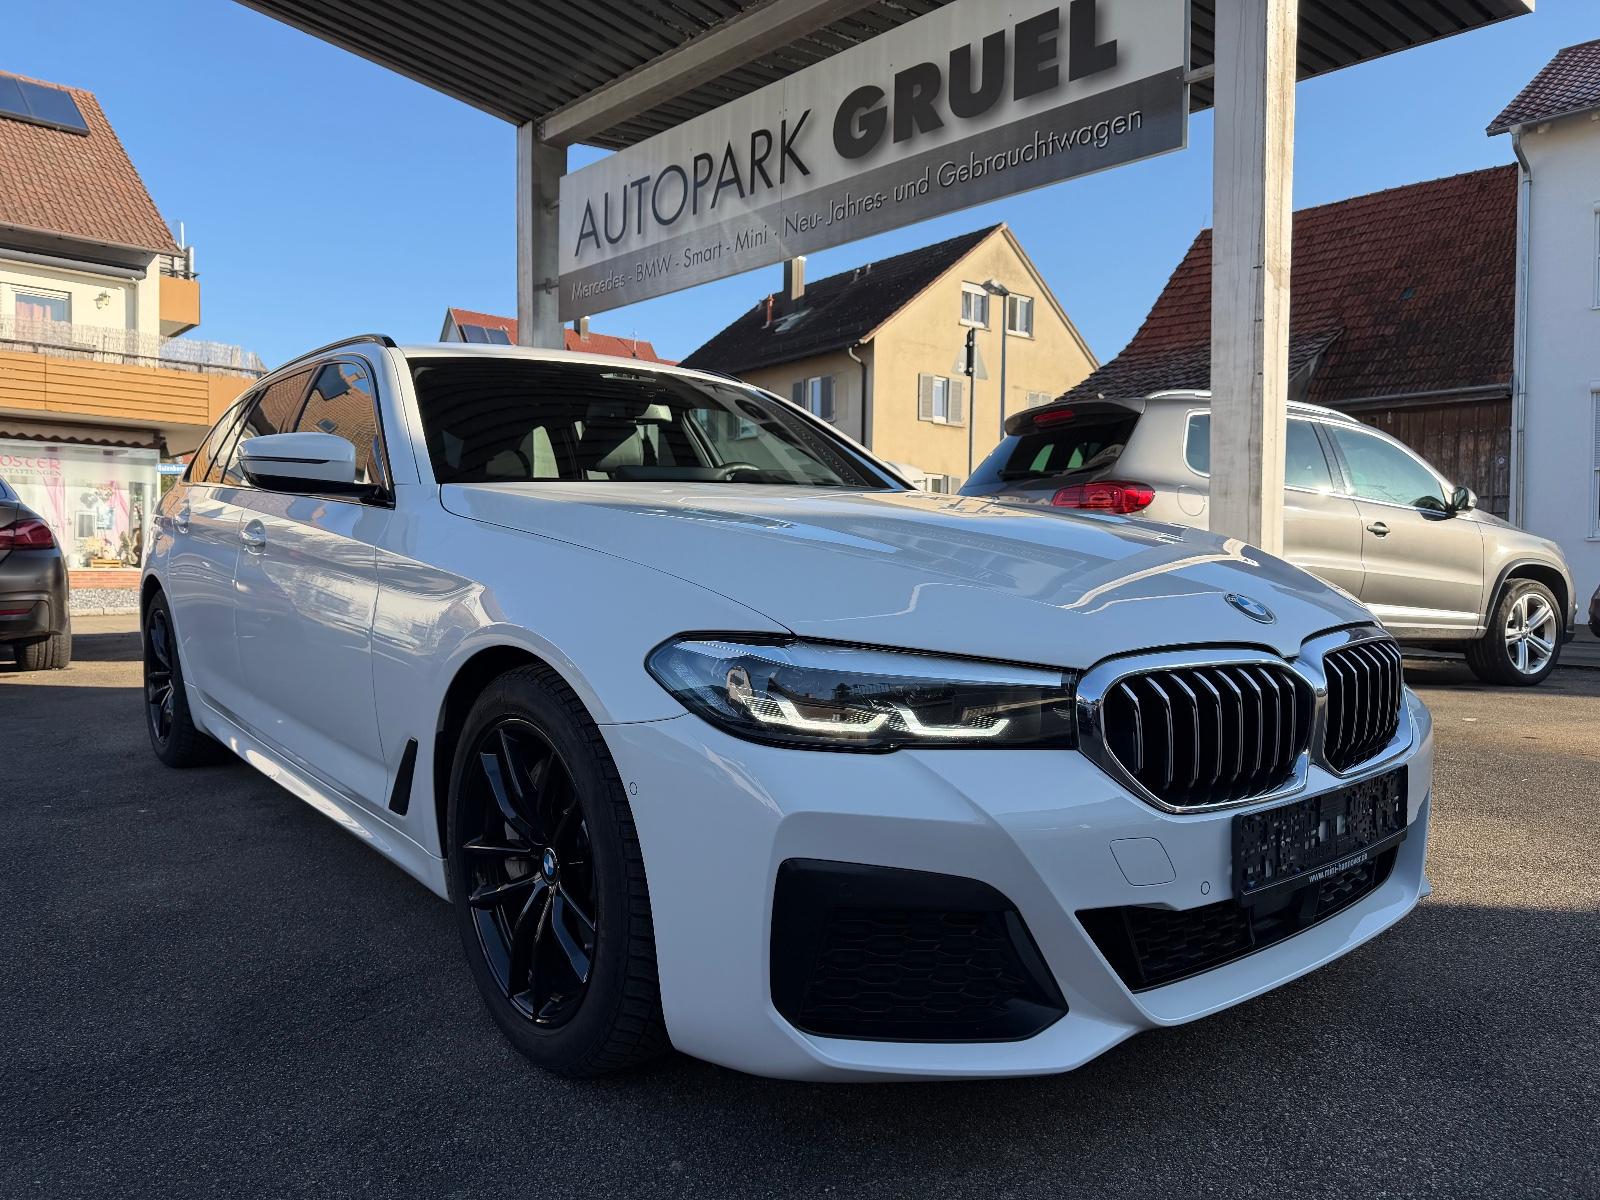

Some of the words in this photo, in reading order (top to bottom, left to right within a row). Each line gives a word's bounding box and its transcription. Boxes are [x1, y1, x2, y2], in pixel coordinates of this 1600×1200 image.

[571, 270, 625, 301] Mercedes
[635, 253, 672, 282] BMW
[683, 241, 722, 268] Smart
[735, 224, 767, 253] Mini
[893, 166, 930, 203] und
[936, 109, 1143, 188] Gebrauchtwagen
[574, 108, 812, 257] AUTOPARK
[833, 0, 1117, 160] GRUEL
